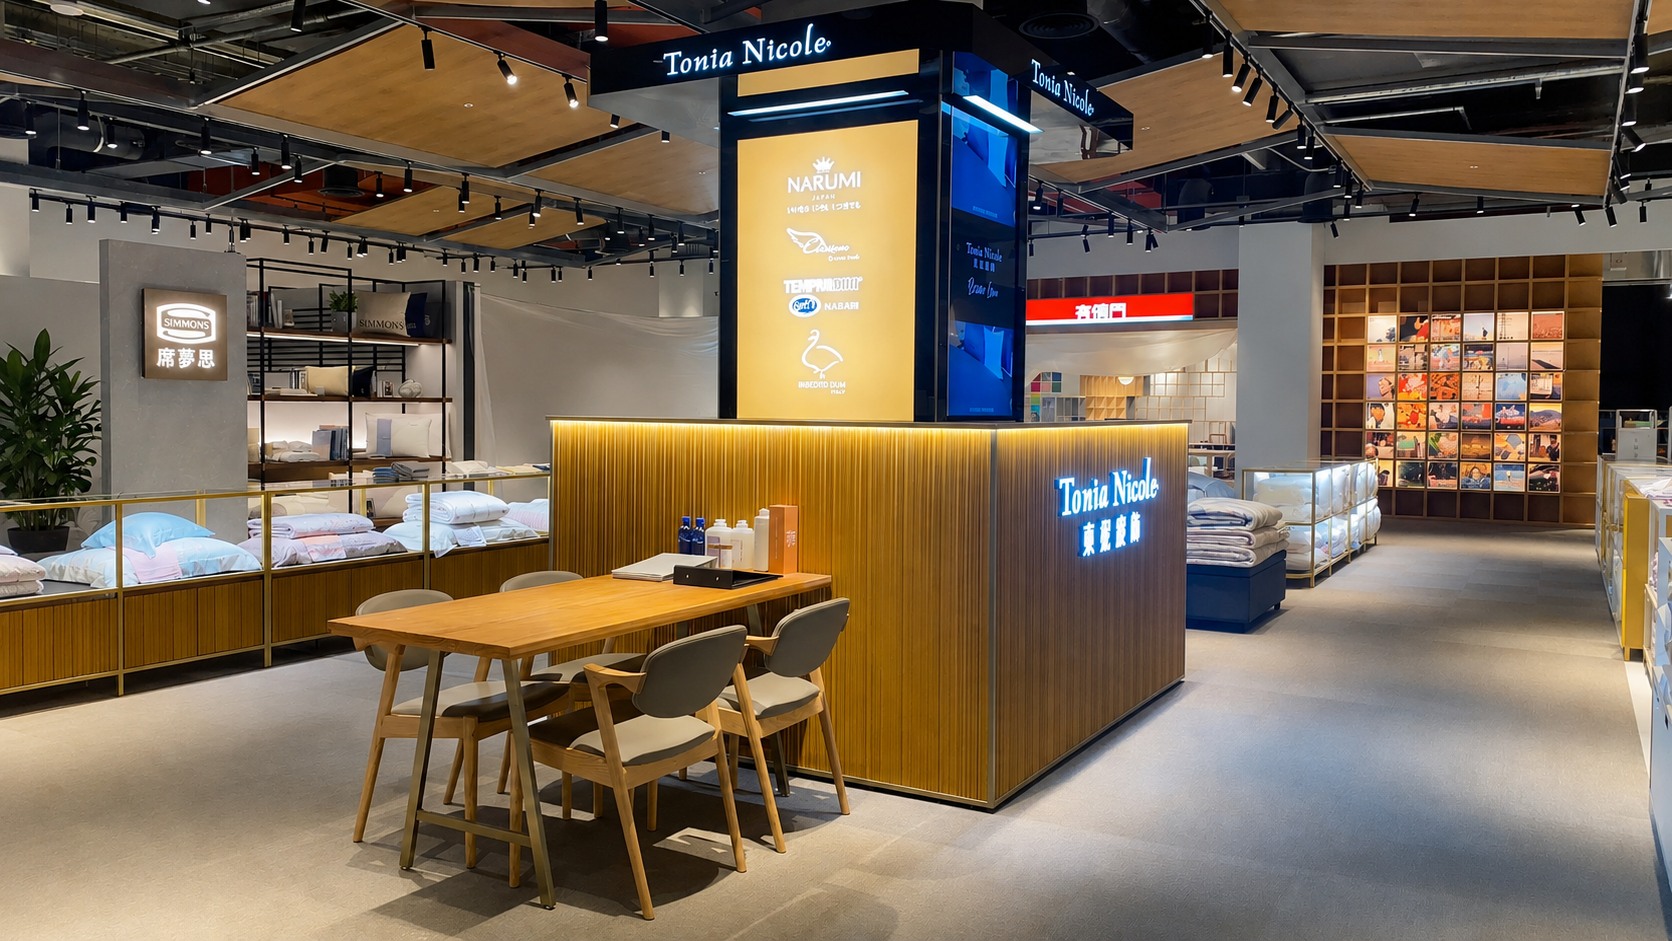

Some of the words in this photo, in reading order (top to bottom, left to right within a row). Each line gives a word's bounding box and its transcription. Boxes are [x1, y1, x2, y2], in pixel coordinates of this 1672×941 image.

[663, 48, 733, 76] Tonia
[742, 23, 832, 65] Nicole
[1031, 58, 1061, 97] Tonia
[1063, 79, 1095, 117] Nicole
[787, 171, 861, 194] NARUMI
[163, 318, 210, 330] SIMMONS
[359, 319, 404, 331] SIMMONS
[156, 347, 216, 369] 席夢思
[1056, 477, 1109, 516] Tonia
[1111, 457, 1159, 506] Nicole
